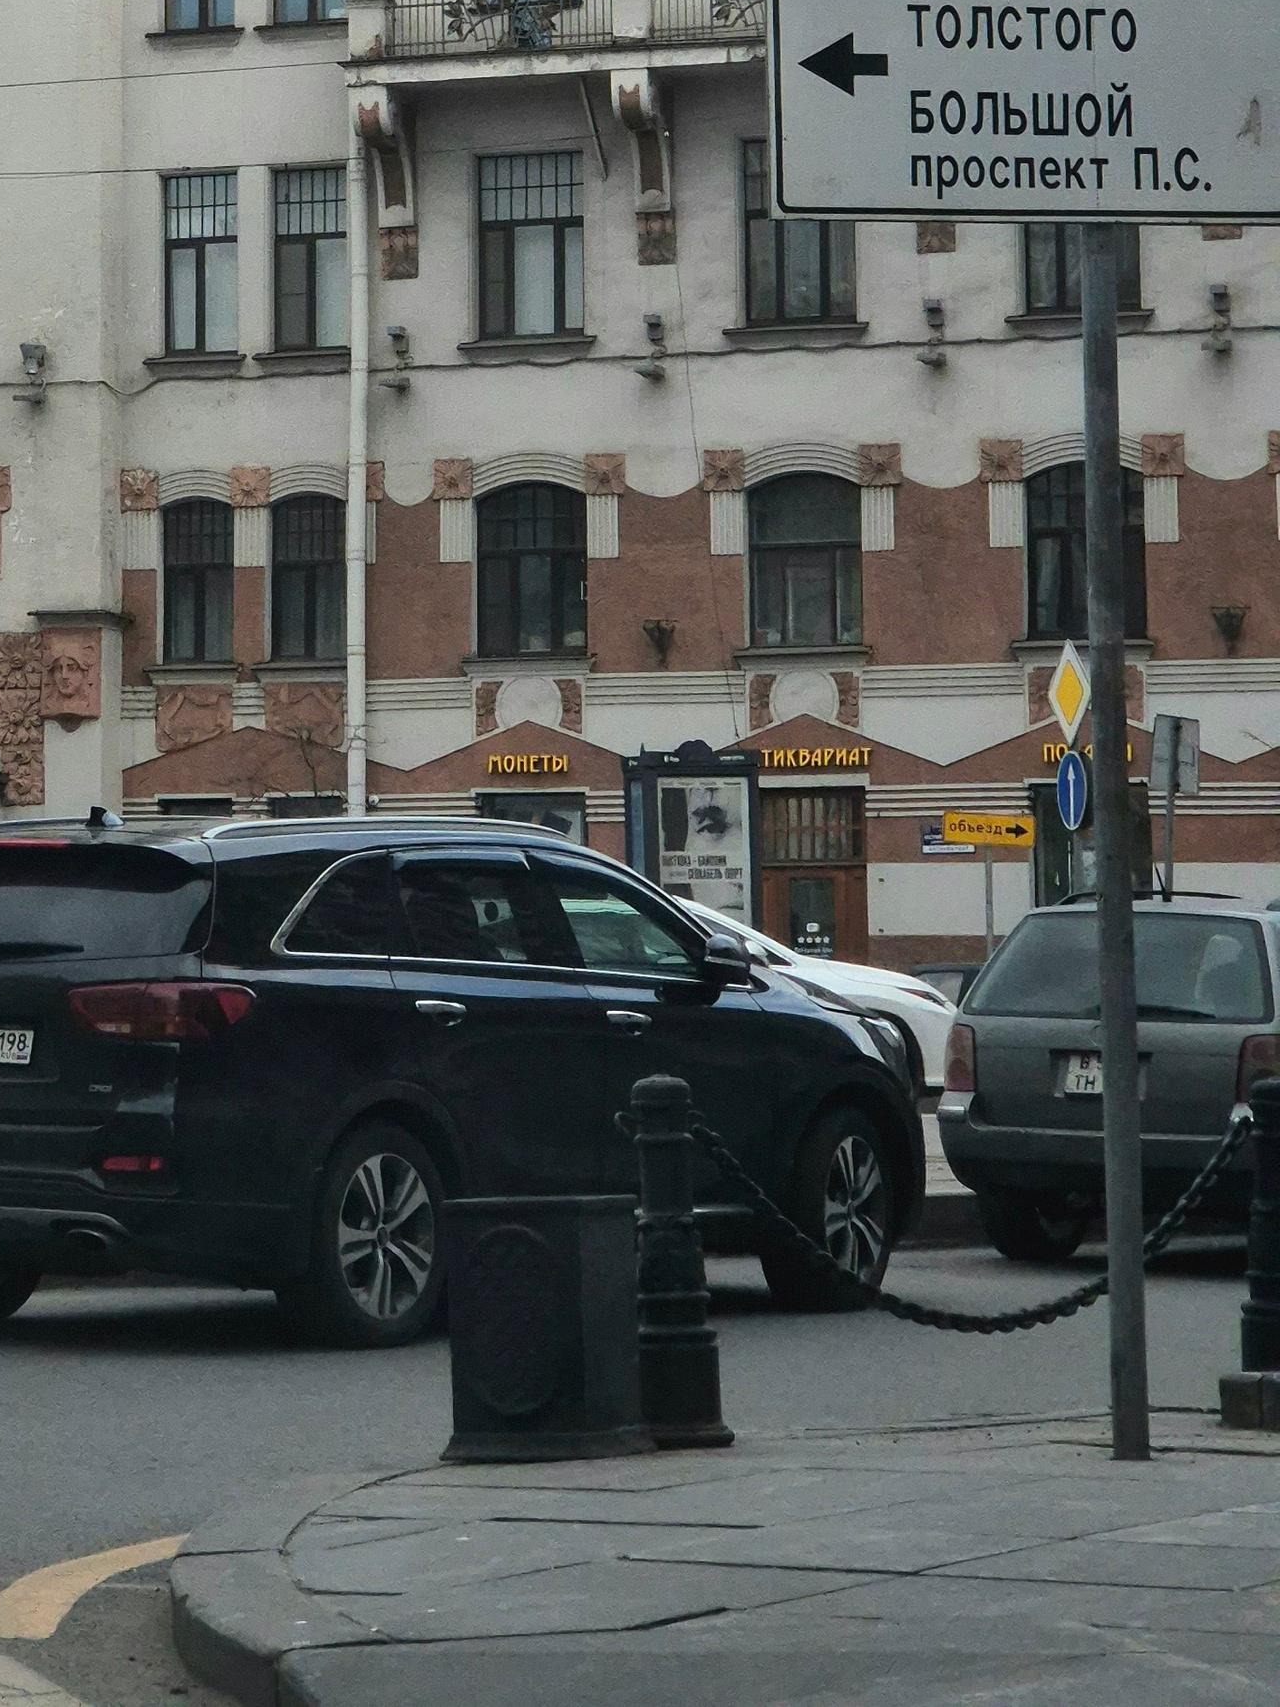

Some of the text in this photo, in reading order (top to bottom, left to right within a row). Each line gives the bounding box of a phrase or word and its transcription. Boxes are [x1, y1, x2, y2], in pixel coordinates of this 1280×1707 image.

[906, 3, 1138, 53] ТОЛСТОГО
[910, 81, 1134, 138] БОЛЬШОЙ
[910, 146, 1212, 200] проспект П.С.
[487, 754, 569, 774] МОНЕТЫ
[760, 746, 872, 768] ТИКВАРИАТ
[949, 819, 1003, 836] объезд
